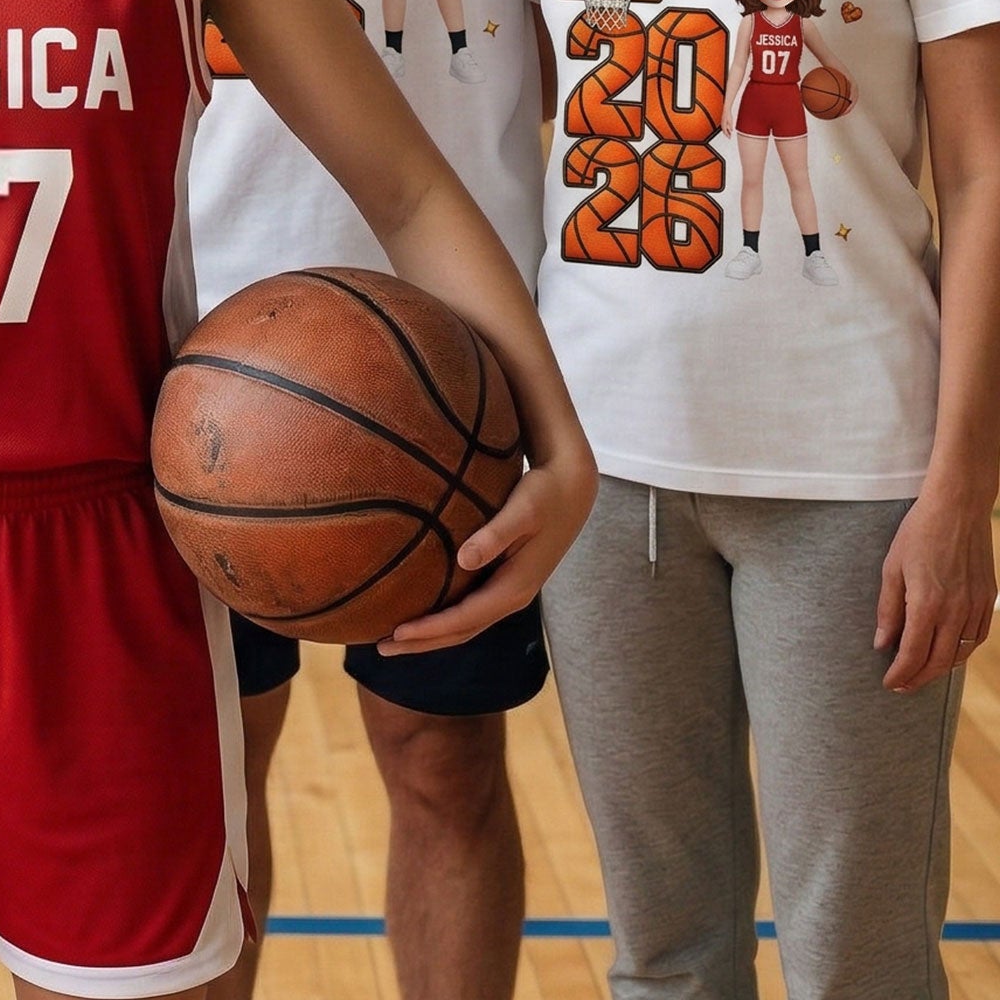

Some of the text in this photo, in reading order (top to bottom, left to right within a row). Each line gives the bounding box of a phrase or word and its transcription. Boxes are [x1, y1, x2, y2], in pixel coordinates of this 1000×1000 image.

[564, 6, 730, 145] 20
[755, 34, 798, 47] JESSICA
[762, 49, 790, 76] 07
[561, 137, 726, 274] 26
